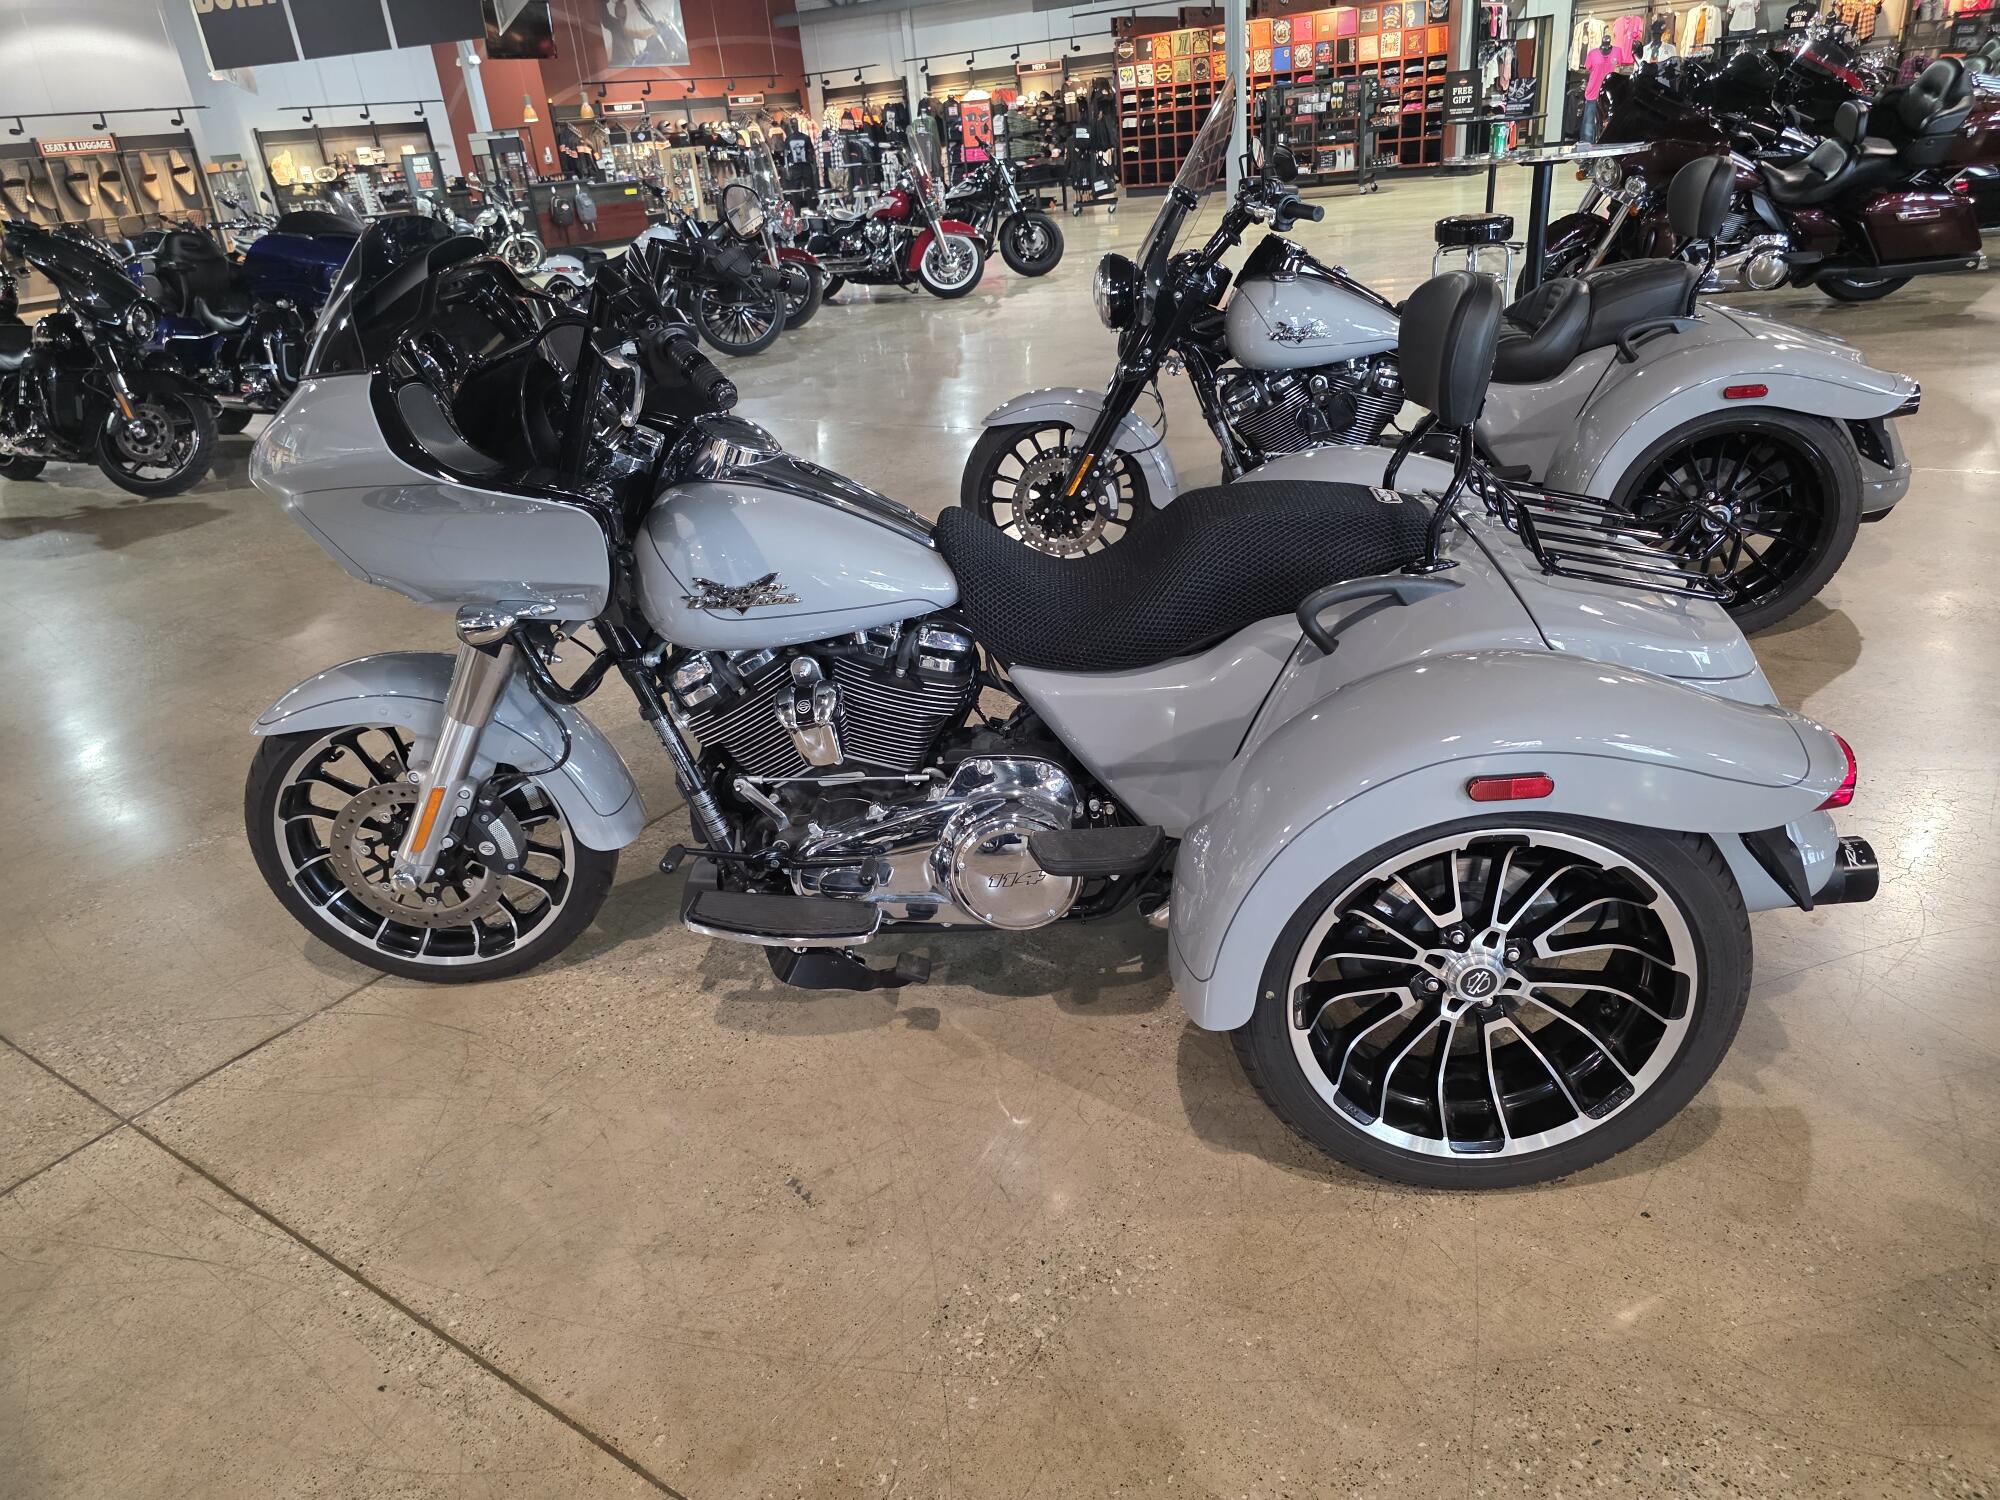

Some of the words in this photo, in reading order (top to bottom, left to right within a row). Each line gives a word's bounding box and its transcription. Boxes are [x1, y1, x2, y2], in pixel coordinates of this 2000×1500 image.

[1452, 86, 1473, 96] FREE
[1452, 95, 1472, 104] GIFT
[44, 143, 67, 152] SEATS
[68, 142, 75, 151] &
[76, 140, 111, 150] LUGGAGE
[988, 869, 1046, 888] 114
